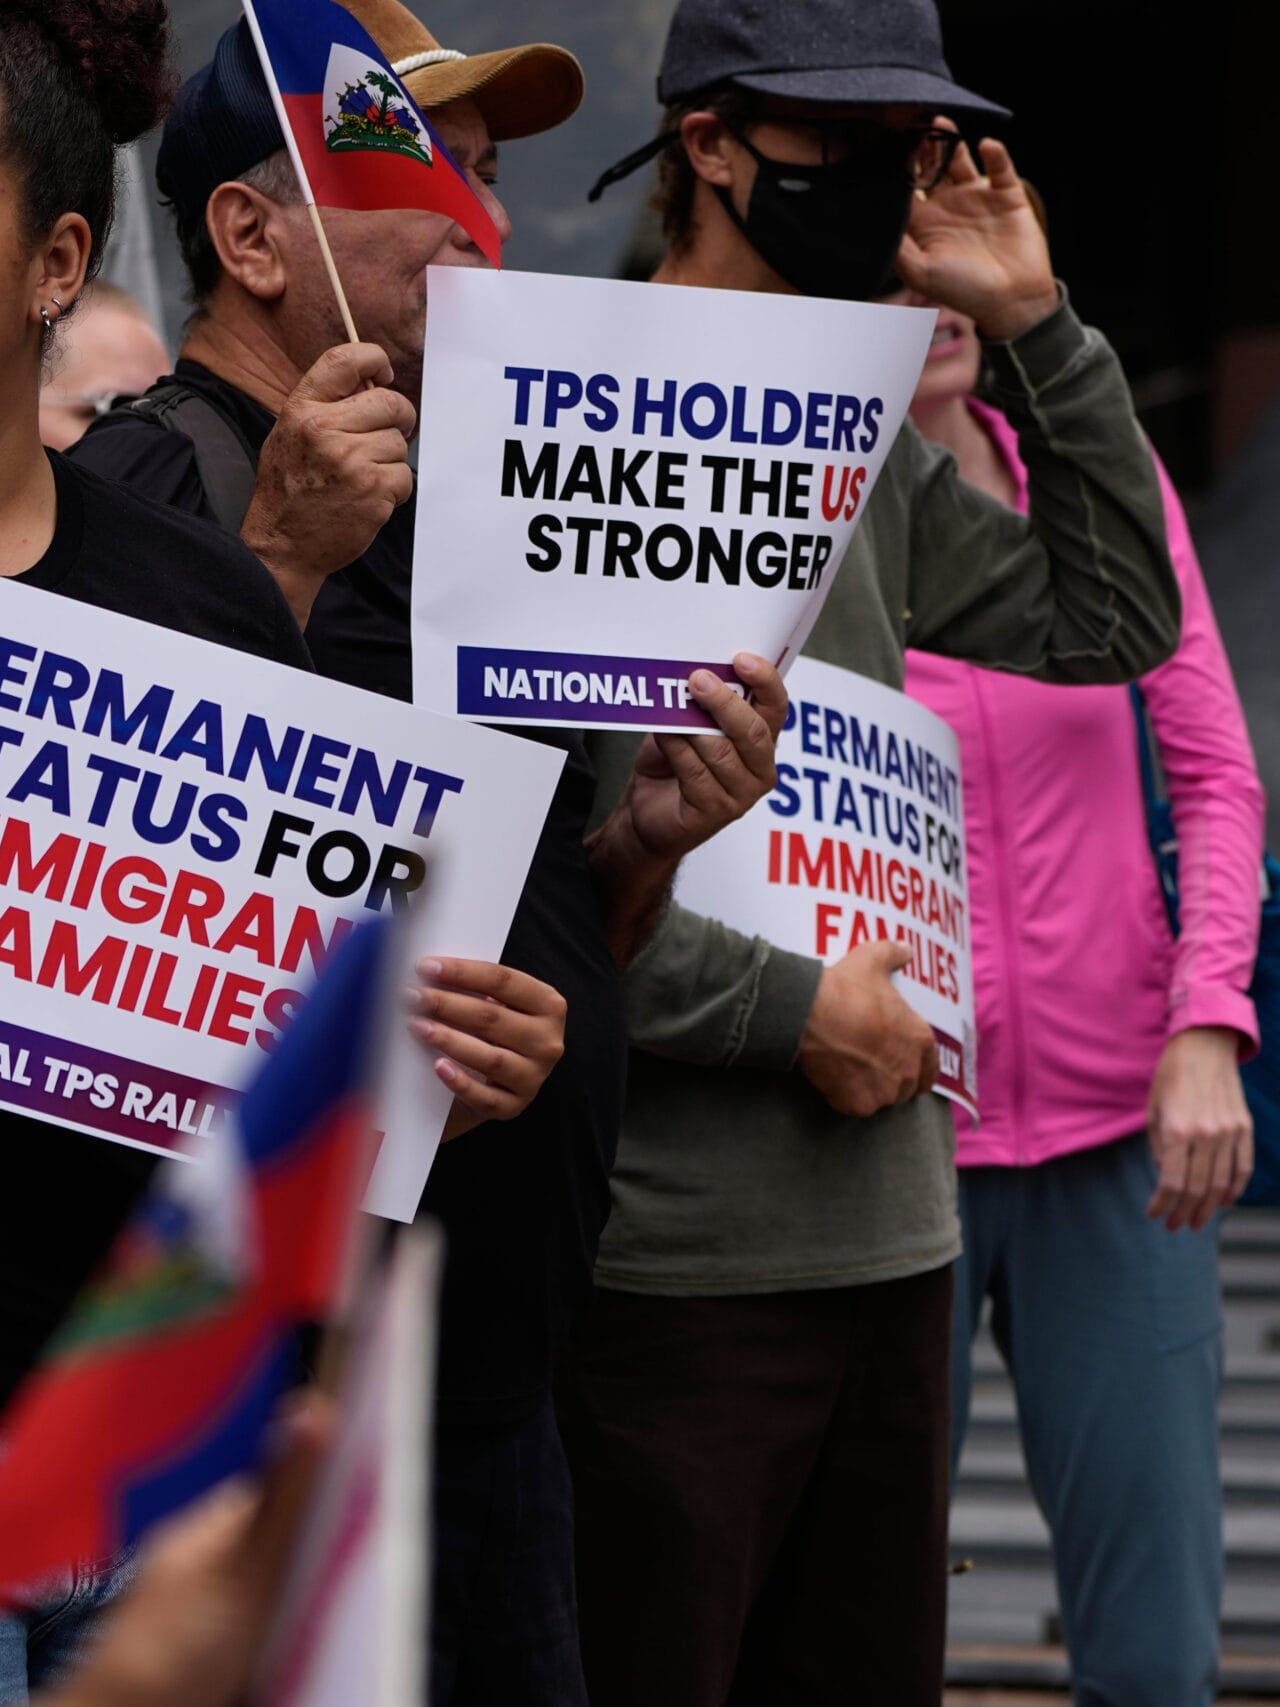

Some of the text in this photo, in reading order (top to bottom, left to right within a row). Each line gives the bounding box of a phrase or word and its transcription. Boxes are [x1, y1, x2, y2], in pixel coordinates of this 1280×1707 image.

[504, 366, 883, 453] TPS HOLDERS
[500, 439, 867, 521] MAKE THE US
[525, 514, 832, 590] STRONGER
[483, 666, 654, 708] NATIONAL
[657, 677, 692, 710] TP
[767, 763, 921, 855] STATUS
[254, 810, 426, 916] FOR
[767, 829, 965, 950] IMMIGRANT
[43, 1056, 120, 1110] TPS
[120, 1081, 234, 1139] RALL
